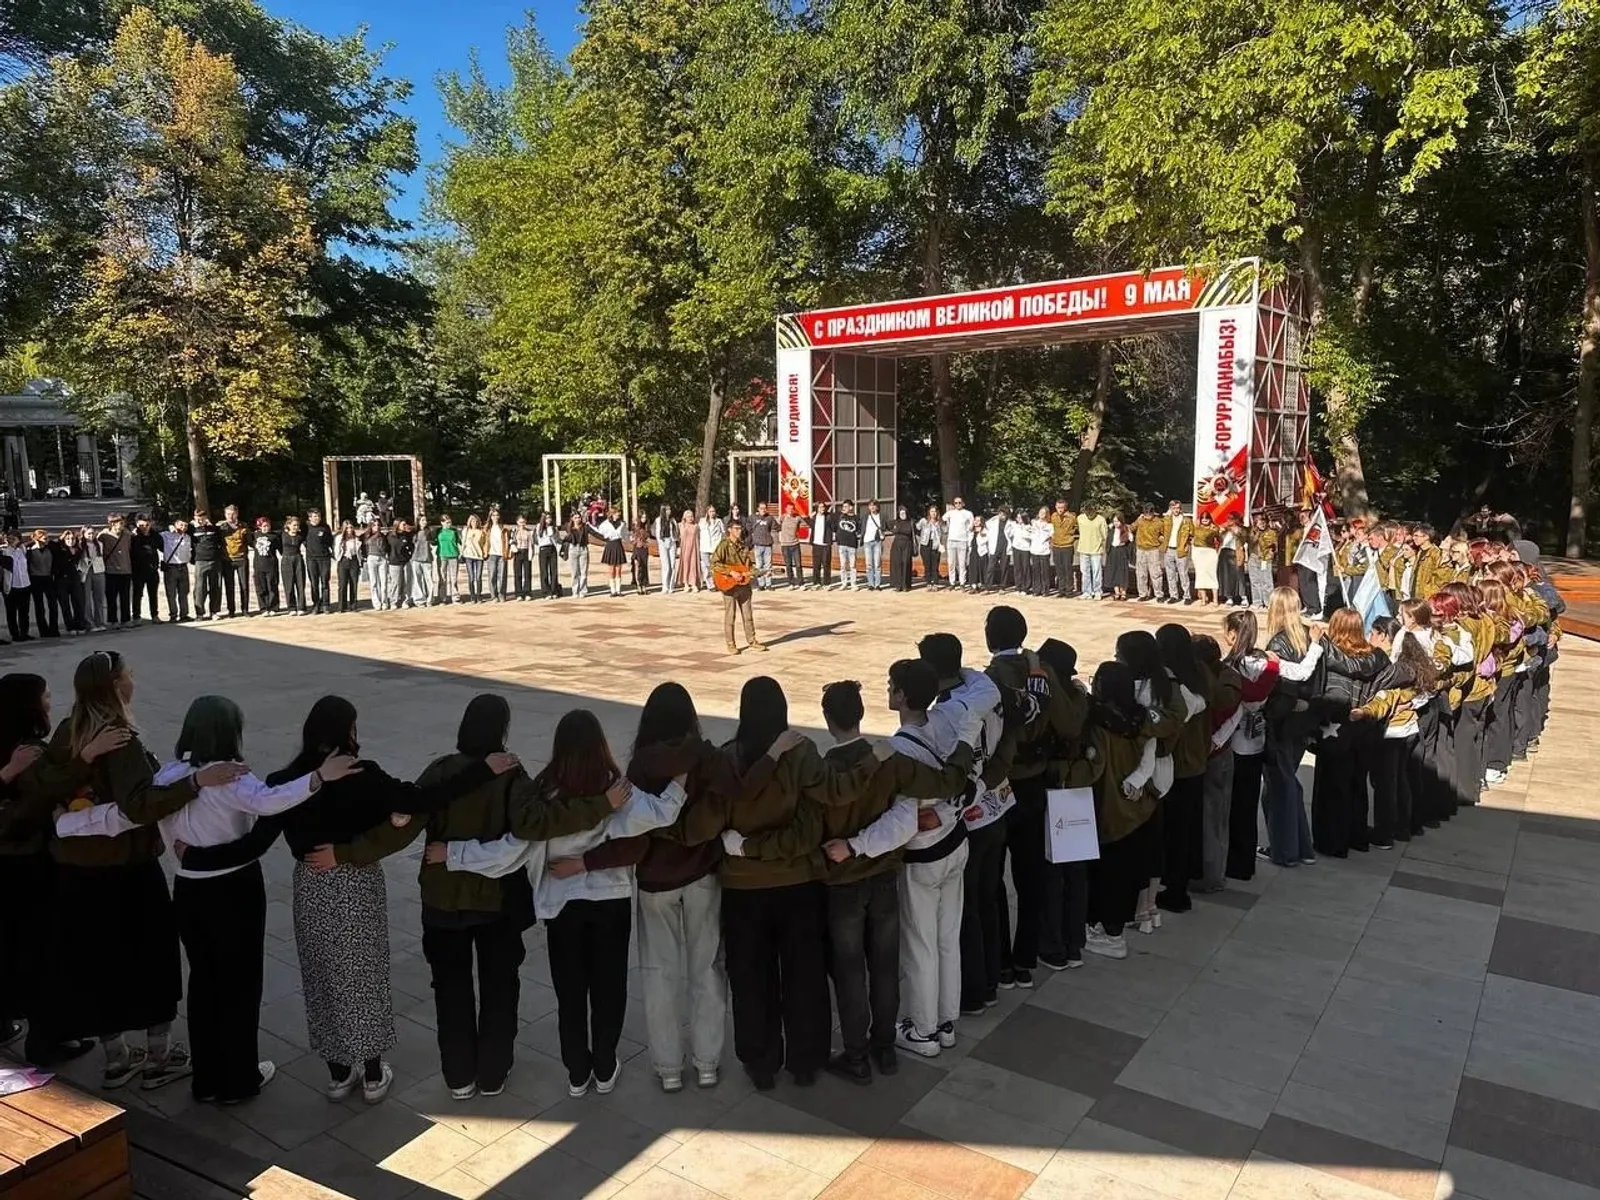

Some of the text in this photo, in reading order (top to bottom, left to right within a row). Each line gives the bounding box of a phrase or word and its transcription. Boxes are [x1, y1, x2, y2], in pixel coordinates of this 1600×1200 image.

[814, 279, 1191, 339] С ПРАЗДНИКОМ ВЕЛИКОЙ ПОБЕДЫ! 9 МАЯ
[789, 374, 800, 442] ГОРДИМСЯ!
